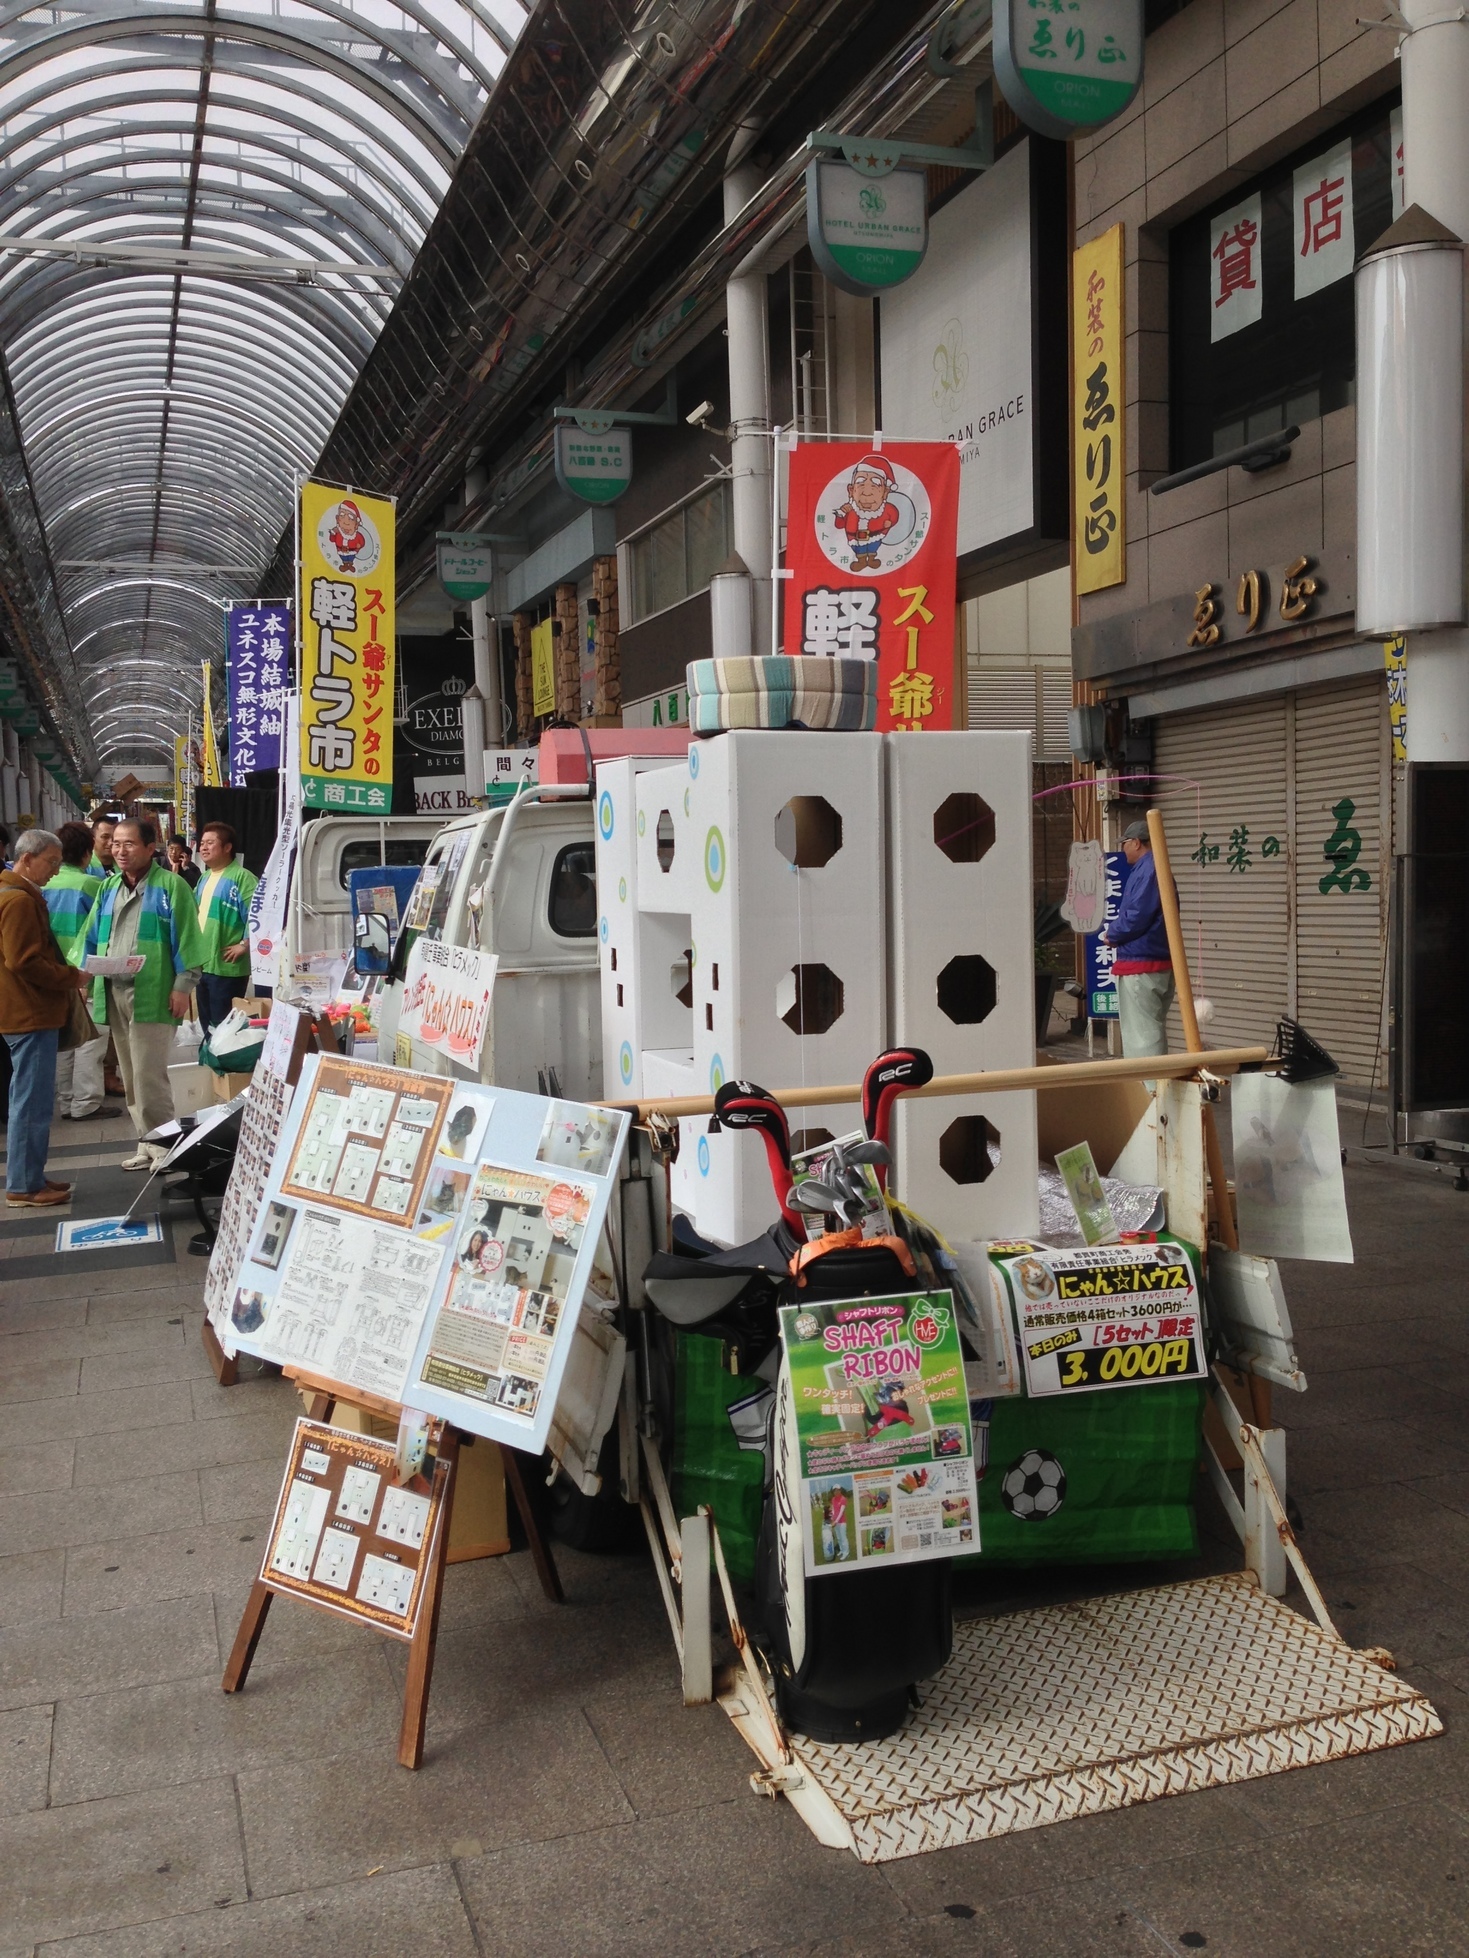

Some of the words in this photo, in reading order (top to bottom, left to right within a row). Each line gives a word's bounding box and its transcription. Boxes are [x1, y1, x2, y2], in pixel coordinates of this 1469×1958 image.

[1054, 80, 1100, 97] ORION
[825, 220, 854, 229] HOTEL
[858, 222, 889, 231] URBAN
[893, 225, 922, 234] GRACE
[856, 252, 894, 265] ORION
[978, 395, 1024, 434] GRACE
[309, 577, 357, 773] 軽トラ市
[361, 588, 386, 776] スー爺サンタの
[652, 692, 690, 726] 八百
[324, 783, 386, 808] 商工会
[844, 1306, 898, 1320] シャフトリボン
[824, 1318, 903, 1352] SHAFT
[1029, 1330, 1078, 1357] 本日のみ
[843, 1346, 922, 1380] RIBON
[803, 1387, 853, 1400] ワンタッチ!
[821, 1403, 865, 1416] 確実固定!
